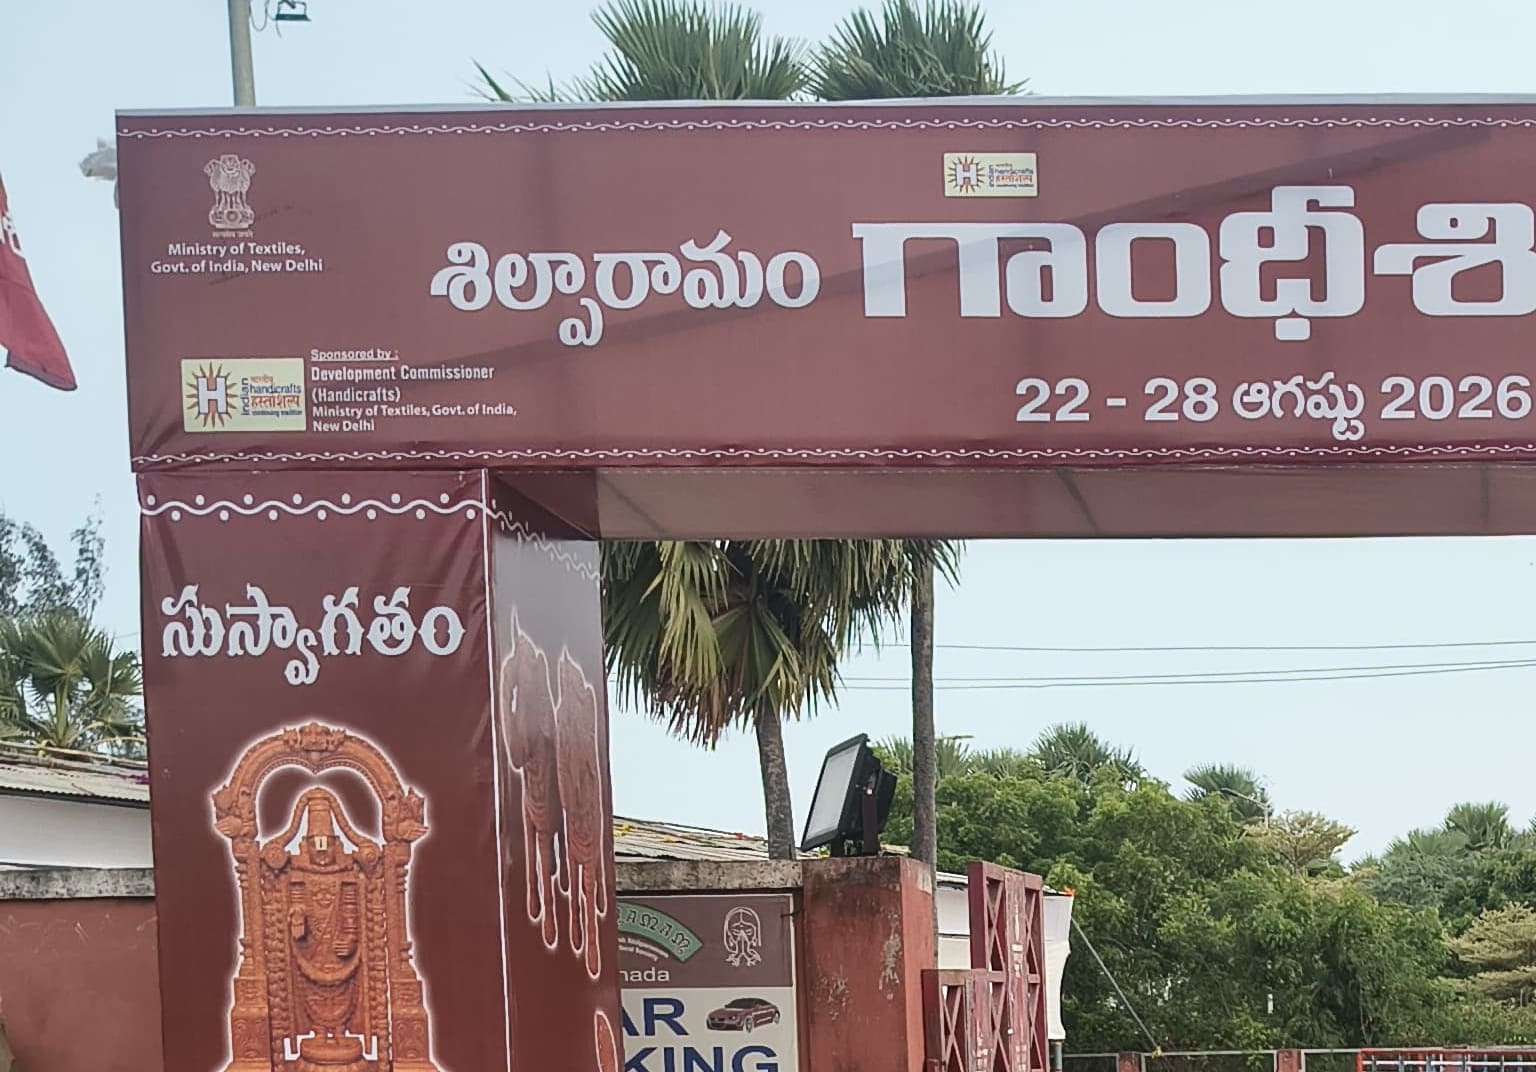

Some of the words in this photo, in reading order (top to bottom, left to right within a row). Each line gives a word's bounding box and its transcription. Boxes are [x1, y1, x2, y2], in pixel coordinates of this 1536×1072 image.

[168, 243, 227, 258] Ministry
[230, 243, 245, 255] of
[248, 242, 305, 256] Textiles,
[151, 261, 189, 273] Govt.
[192, 260, 206, 273] of
[209, 259, 248, 273] India,
[251, 259, 281, 272] New
[286, 259, 323, 272] Delhi
[430, 231, 821, 346] శిల్పారామం
[311, 349, 374, 361] Sponsored
[376, 349, 391, 361] by
[311, 367, 397, 382] Development
[400, 365, 495, 380] Commissioner
[312, 387, 401, 403] (Handicrafts)
[313, 405, 361, 419] Ministry
[365, 404, 378, 416] of
[381, 404, 430, 417] Textiles,
[432, 404, 465, 416] Govt.
[467, 404, 480, 416] of
[482, 403, 517, 417] India,
[1016, 378, 1090, 421] 22
[1144, 377, 1219, 421] 28
[1232, 372, 1364, 441] ఆగష్టు
[1380, 376, 1532, 420] 2026
[313, 420, 340, 432] New
[343, 420, 375, 432] Delhi
[161, 583, 465, 685] సుస్వాగతం
